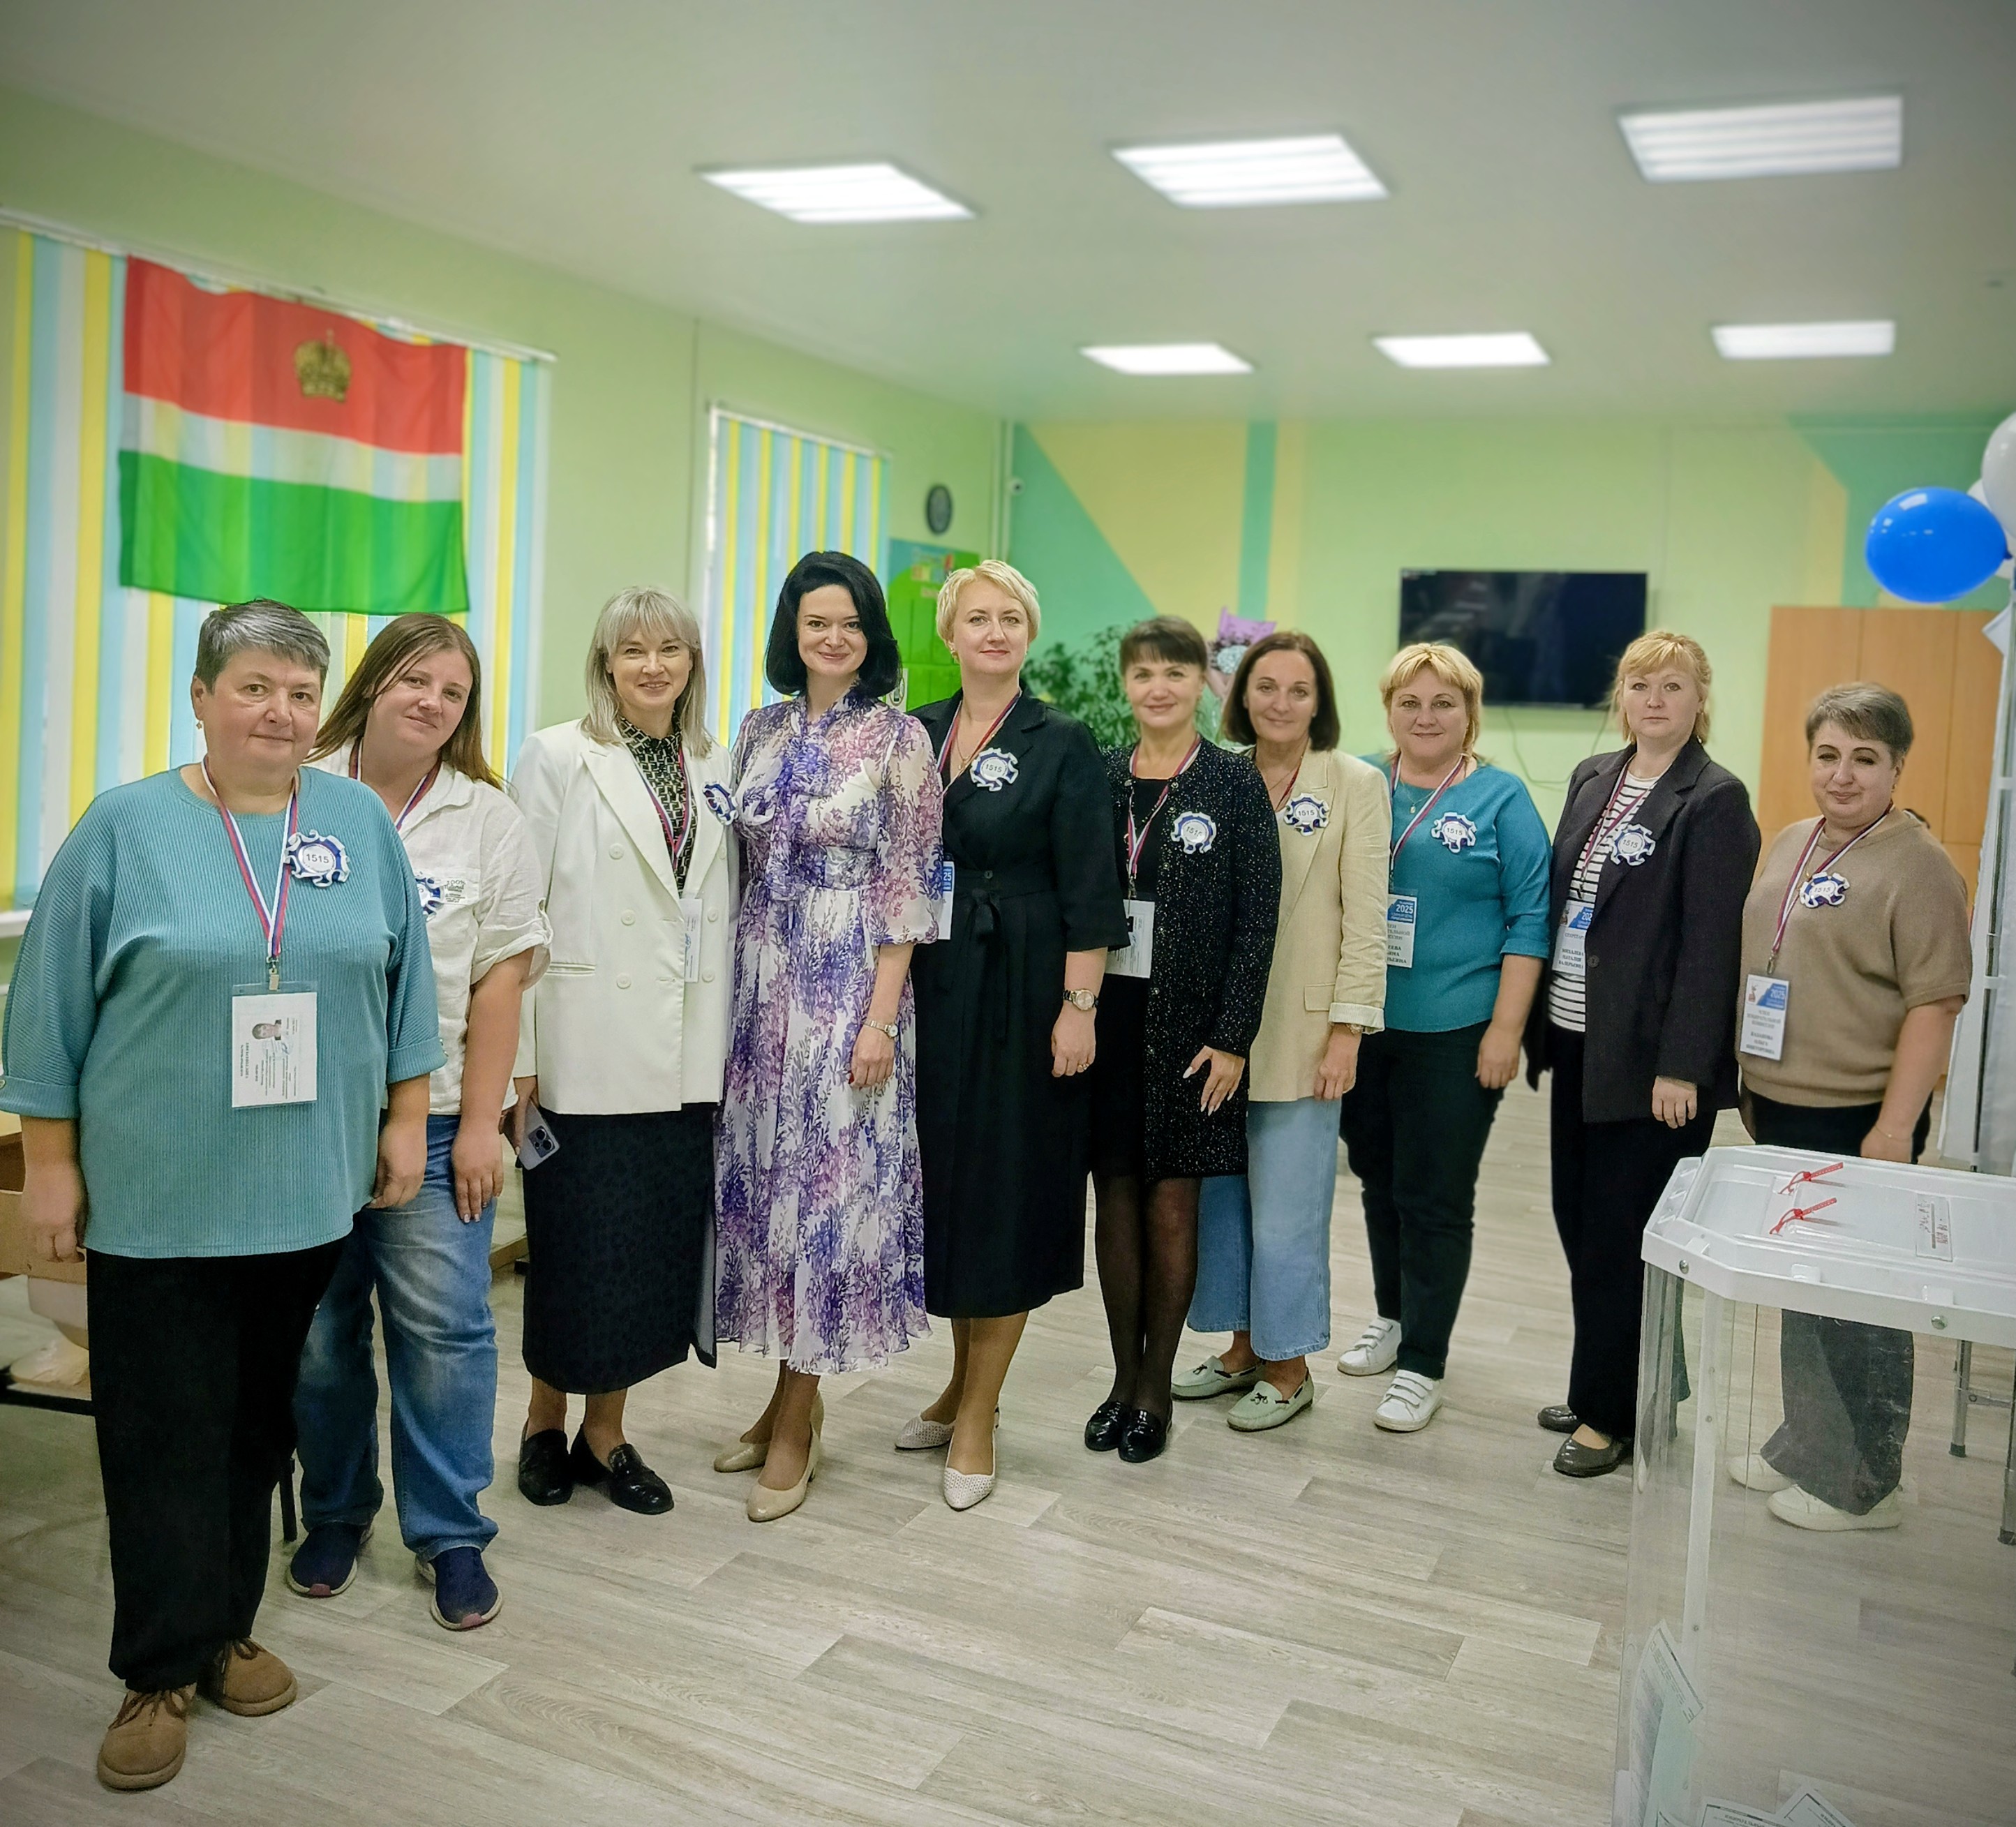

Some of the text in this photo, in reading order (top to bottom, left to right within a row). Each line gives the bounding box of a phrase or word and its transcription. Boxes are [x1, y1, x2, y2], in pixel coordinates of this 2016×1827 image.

[986, 764, 1002, 773] 1515
[1447, 828, 1463, 836] 1515
[1623, 839, 1638, 849] 1515
[306, 853, 329, 864] 1515
[943, 872, 952, 881] 25
[1396, 904, 1414, 914] 2025
[1581, 912, 1592, 921] 202
[1770, 989, 1785, 999] 2025
